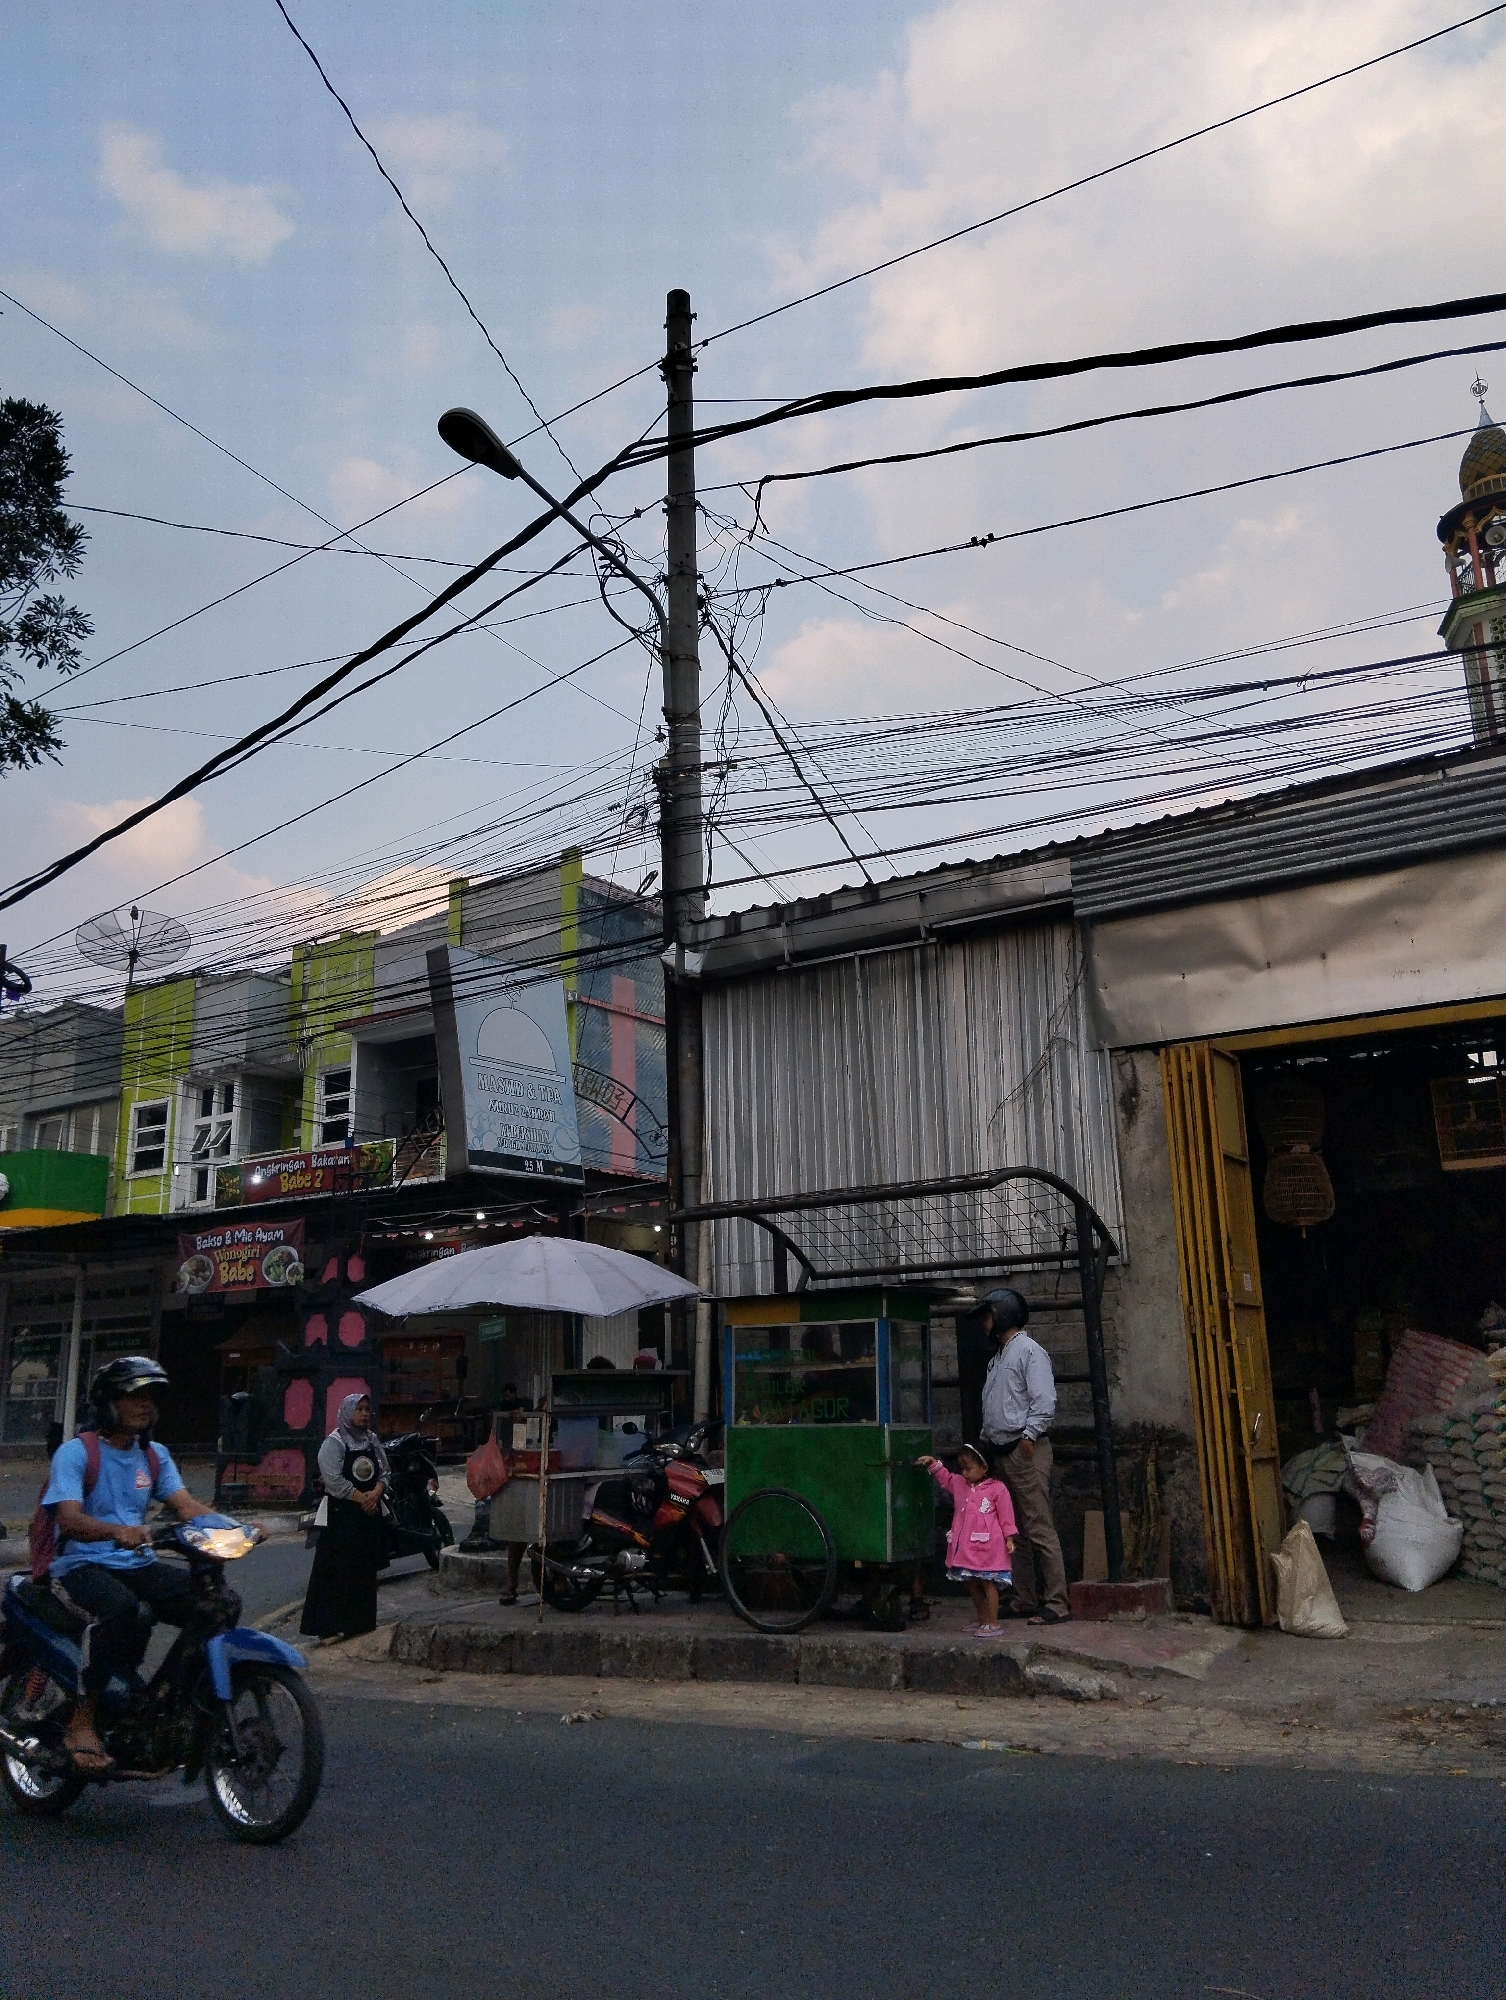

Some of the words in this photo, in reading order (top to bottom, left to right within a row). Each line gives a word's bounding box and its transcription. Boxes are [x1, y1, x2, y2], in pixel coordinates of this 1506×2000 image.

[527, 1083, 537, 1100] &
[538, 1084, 563, 1105] TPA
[254, 1159, 306, 1177] Angkringan
[535, 1159, 545, 1173] M
[279, 1169, 312, 1193] Babe
[314, 1168, 324, 1188] 2
[195, 1234, 223, 1250] Bakso
[225, 1229, 232, 1245] &
[254, 1226, 285, 1243] Ayam
[213, 1243, 261, 1263] Wonogiri
[219, 1259, 255, 1285] Babe
[669, 1492, 691, 1506] YAMAHA
